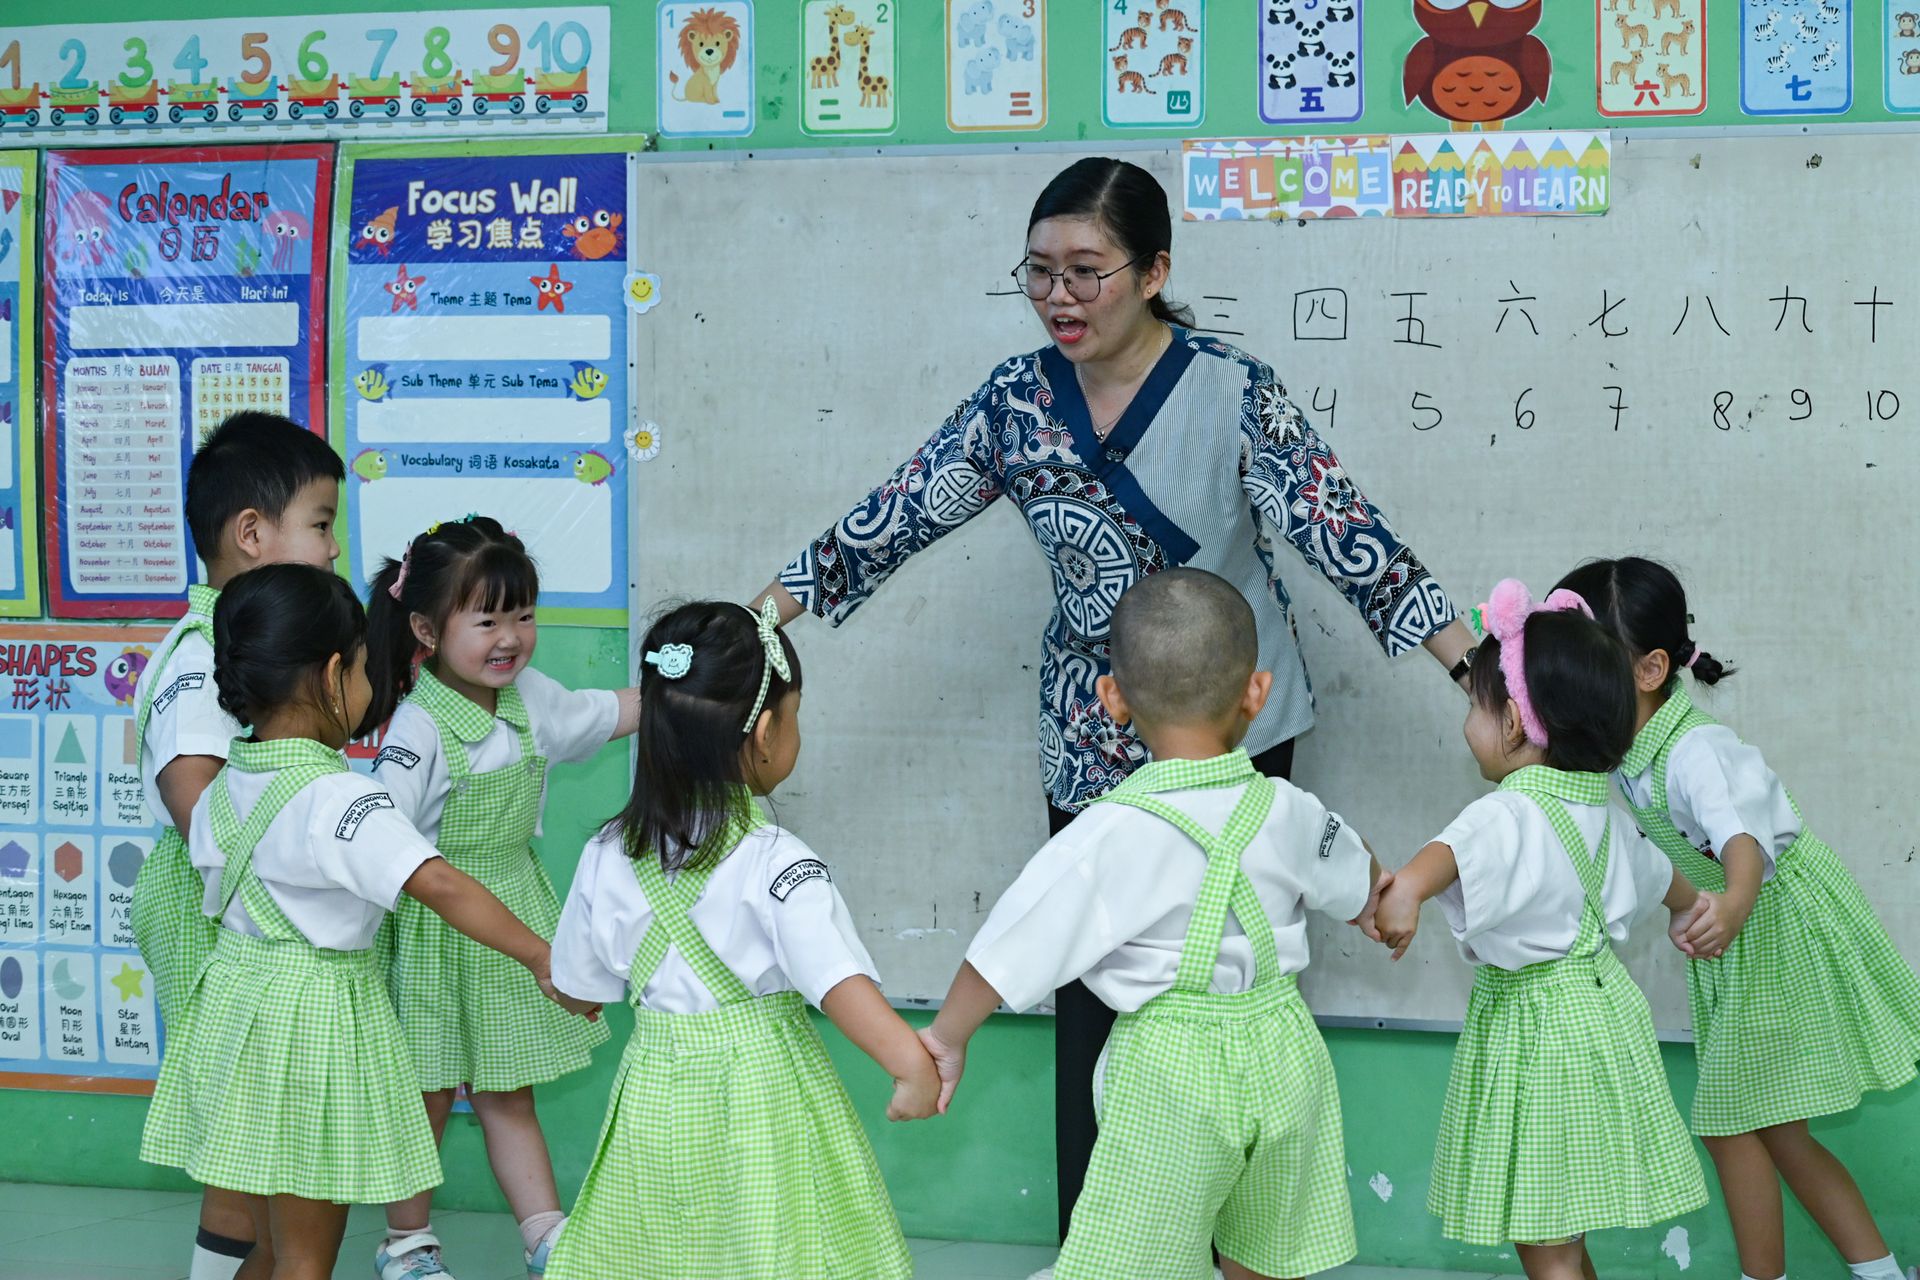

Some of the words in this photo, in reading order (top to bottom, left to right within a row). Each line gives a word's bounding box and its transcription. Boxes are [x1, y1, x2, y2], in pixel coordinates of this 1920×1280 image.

[876, 3, 888, 23] 2
[1022, 0, 1035, 18] 3
[1113, 0, 1128, 15] 4
[666, 9, 674, 28] 1
[0, 40, 20, 90] 1
[59, 38, 88, 88] 2
[119, 37, 153, 87] 3
[173, 34, 208, 86] 4
[242, 33, 271, 84] 5
[297, 30, 328, 81] 6
[366, 29, 397, 81] 7
[423, 26, 452, 78] 8
[488, 24, 520, 76] 9
[527, 21, 592, 74] 10
[1634, 80, 1660, 107] 六
[1785, 74, 1812, 102] 七
[1009, 92, 1033, 116] 三
[1167, 90, 1191, 115] 四
[1299, 87, 1325, 112] 五
[722, 110, 745, 118] 一
[818, 99, 841, 121] 二
[1194, 166, 1382, 201] WELCOME
[1401, 175, 1488, 209] READY
[1491, 185, 1512, 203] TO
[1519, 175, 1606, 207] LEARN
[118, 173, 269, 226] Calendar
[407, 180, 497, 216] Focus
[510, 177, 578, 215] Wall
[427, 217, 545, 250] 学习焦点
[159, 225, 220, 262] 日历
[78, 289, 112, 306] Today
[118, 289, 129, 302] Is
[160, 286, 205, 302] 今天是
[241, 286, 267, 300] Hari
[430, 292, 464, 305] Theme
[469, 291, 497, 306] 主题
[503, 293, 532, 305] Tema
[1195, 296, 1244, 335] 三
[1294, 288, 1347, 340] 四
[1390, 292, 1442, 348] 五
[1496, 280, 1539, 335] 六
[1589, 289, 1628, 338] 七
[1673, 296, 1730, 336] 八
[1768, 285, 1813, 333] 九
[1854, 286, 1893, 343] 十
[73, 366, 107, 376] MONTHS
[139, 364, 170, 376] BULAN
[201, 363, 222, 374] DATE
[202, 378, 206, 386] 1
[214, 378, 220, 387] 2
[226, 377, 232, 386] 3
[239, 378, 245, 386] 4
[250, 377, 257, 386] 5
[263, 377, 270, 386] 6
[276, 377, 281, 386] 7
[402, 374, 424, 388] Sub
[428, 373, 463, 388] Theme
[468, 373, 496, 389] 单元
[501, 374, 524, 388] Sub
[529, 375, 559, 389] Tema
[202, 394, 208, 402] 8
[214, 394, 220, 402] 9
[223, 394, 232, 402] 10
[237, 394, 244, 402] 11
[248, 393, 257, 402] 12
[261, 393, 269, 402] 13
[273, 394, 282, 402] 14
[1312, 387, 1336, 428] 4
[1411, 391, 1442, 431] 5
[1515, 388, 1535, 430] 6
[1603, 387, 1629, 431] 7
[1713, 391, 1733, 431] 8
[1789, 389, 1812, 421] 9
[1867, 390, 1900, 421] 10
[401, 453, 463, 473] Vocabulary
[468, 455, 498, 470] 词语
[504, 456, 560, 470] Kosakata
[81, 504, 103, 517] August
[76, 523, 112, 534] September
[138, 523, 175, 534] September
[79, 558, 111, 566] November
[80, 574, 111, 582] December
[12, 678, 71, 711] 形状
[54, 771, 88, 789] Triangle
[55, 786, 87, 799] 三角形
[53, 800, 89, 817] Segitiga
[343, 808, 357, 826] INDO
[350, 801, 381, 825] TARAKAN
[781, 868, 798, 883] INDO
[787, 869, 822, 887] TARAKAN
[53, 889, 87, 906] Hexagon
[52, 905, 84, 918] 六角形
[49, 919, 67, 936] Segi
[71, 920, 92, 931] Enam
[0, 1003, 19, 1013] Oval
[60, 1005, 83, 1016] Moon
[118, 1009, 139, 1020] Star
[62, 1019, 83, 1031] 月形
[120, 1022, 141, 1036] 星形
[1, 1031, 21, 1041] Oval
[115, 1037, 150, 1055] Bintang
